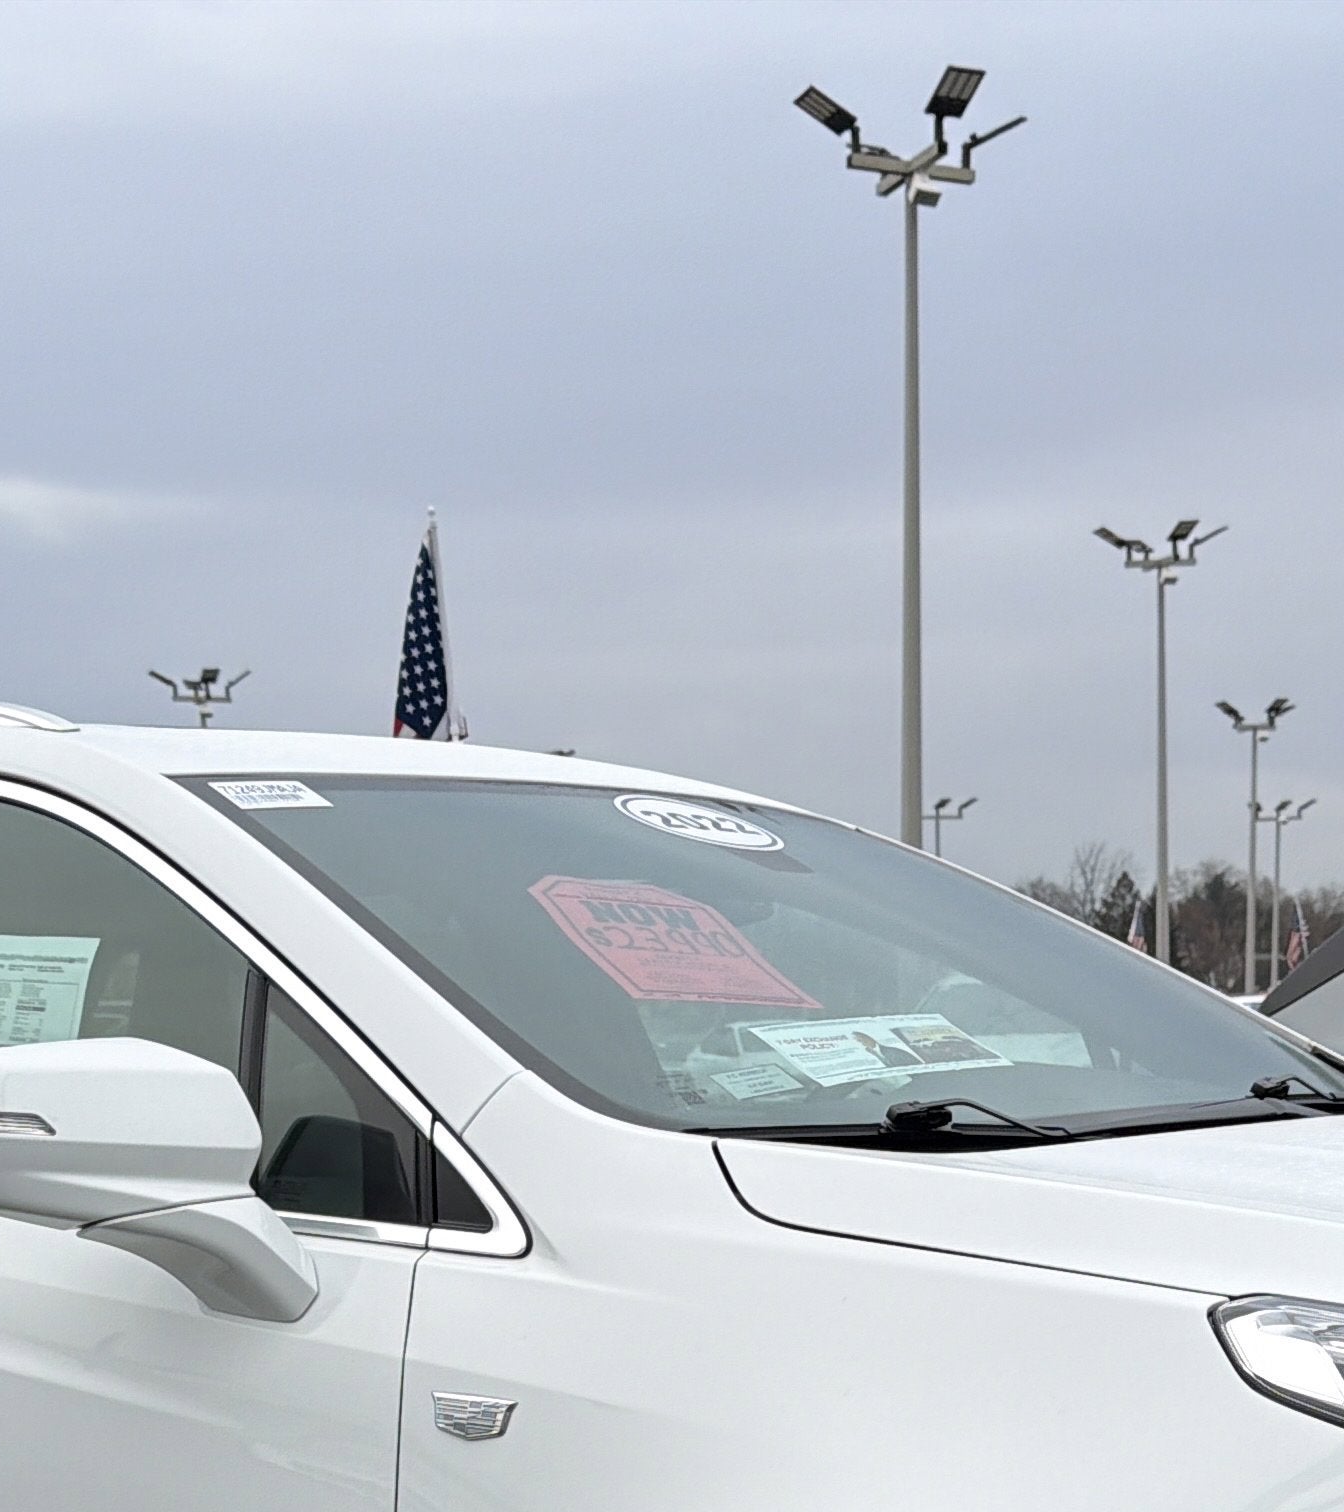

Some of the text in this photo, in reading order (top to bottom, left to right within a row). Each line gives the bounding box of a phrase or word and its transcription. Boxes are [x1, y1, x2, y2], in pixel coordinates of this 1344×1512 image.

[640, 810, 763, 835] 2022
[577, 899, 701, 931] NOW
[800, 1042, 837, 1050] POLICY
